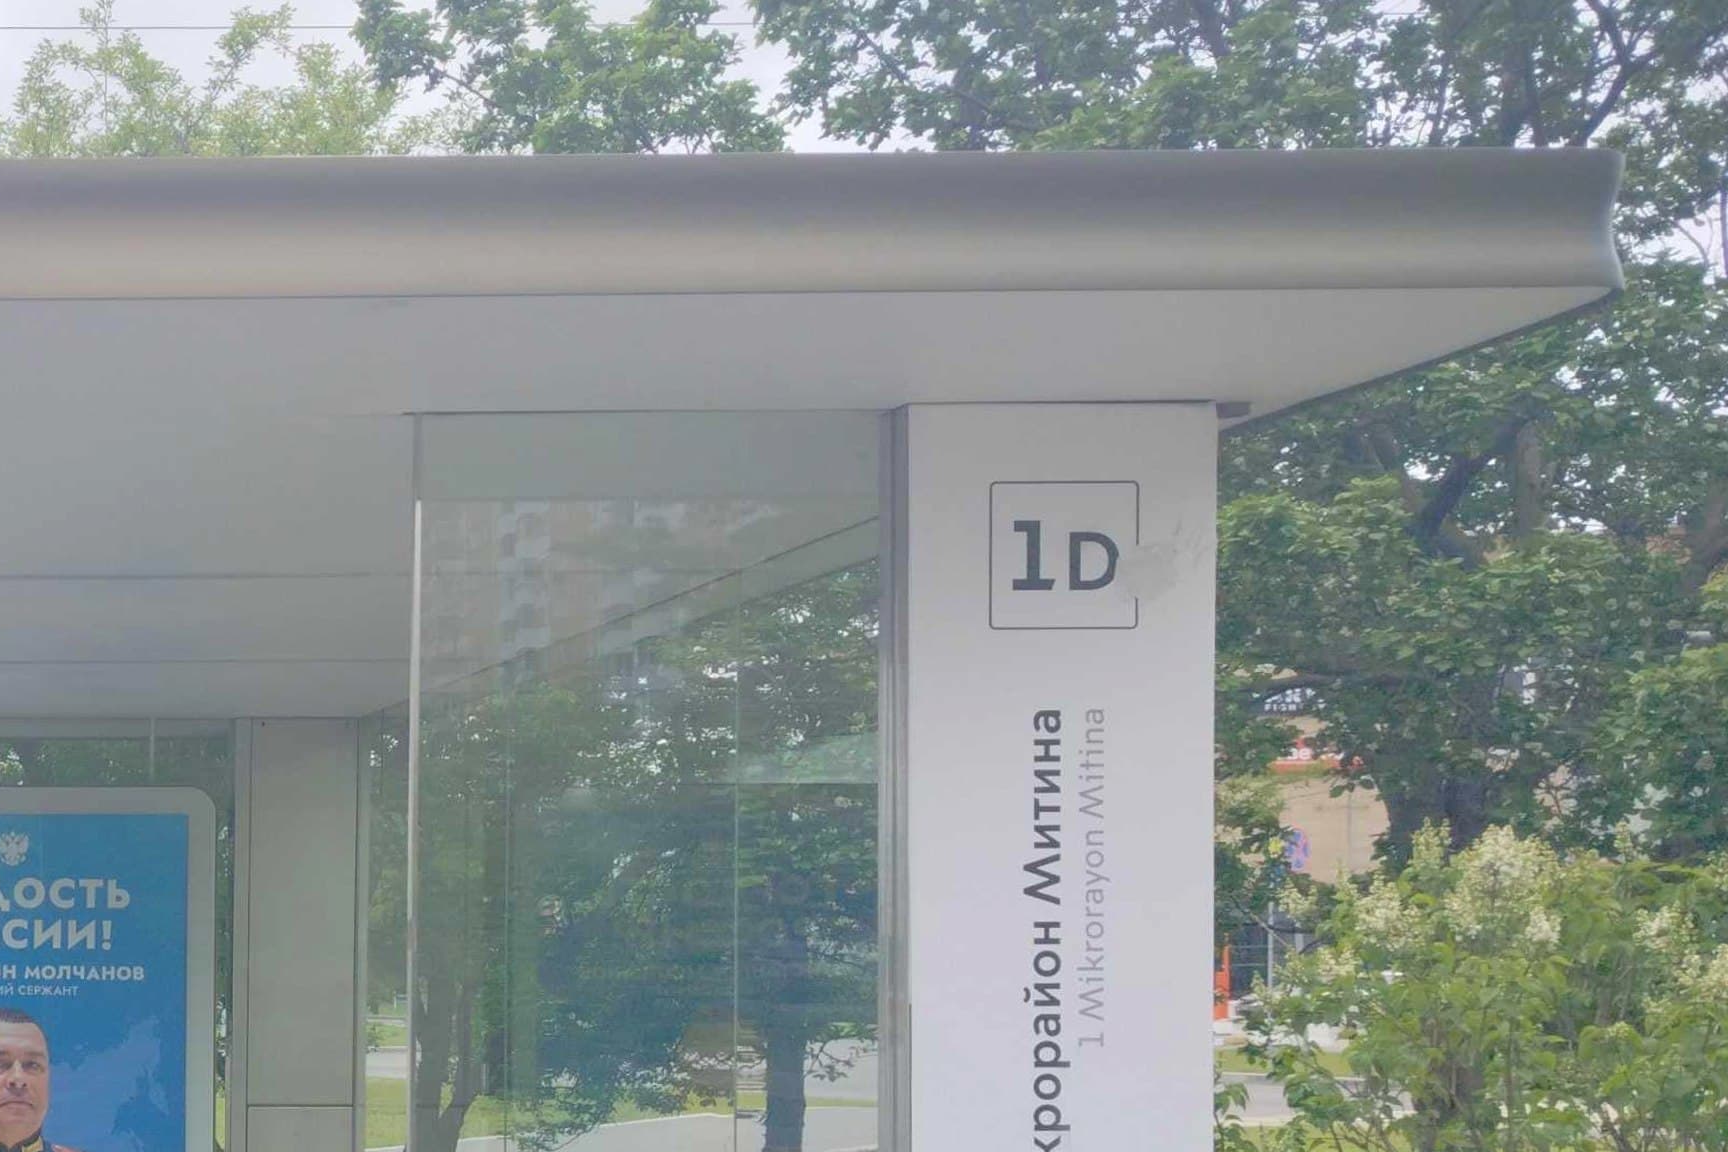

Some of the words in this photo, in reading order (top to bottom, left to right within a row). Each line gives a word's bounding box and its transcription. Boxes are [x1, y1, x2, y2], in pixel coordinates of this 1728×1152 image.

[1076, 706, 1106, 821] Mitina
[1023, 708, 1062, 905] Митина
[1076, 826, 1111, 1022] Mikrorayon
[17, 984, 79, 998] СЕРЖАНТ
[25, 963, 146, 983] МОЛЧАНОВ
[1078, 1030, 1105, 1048] 1
